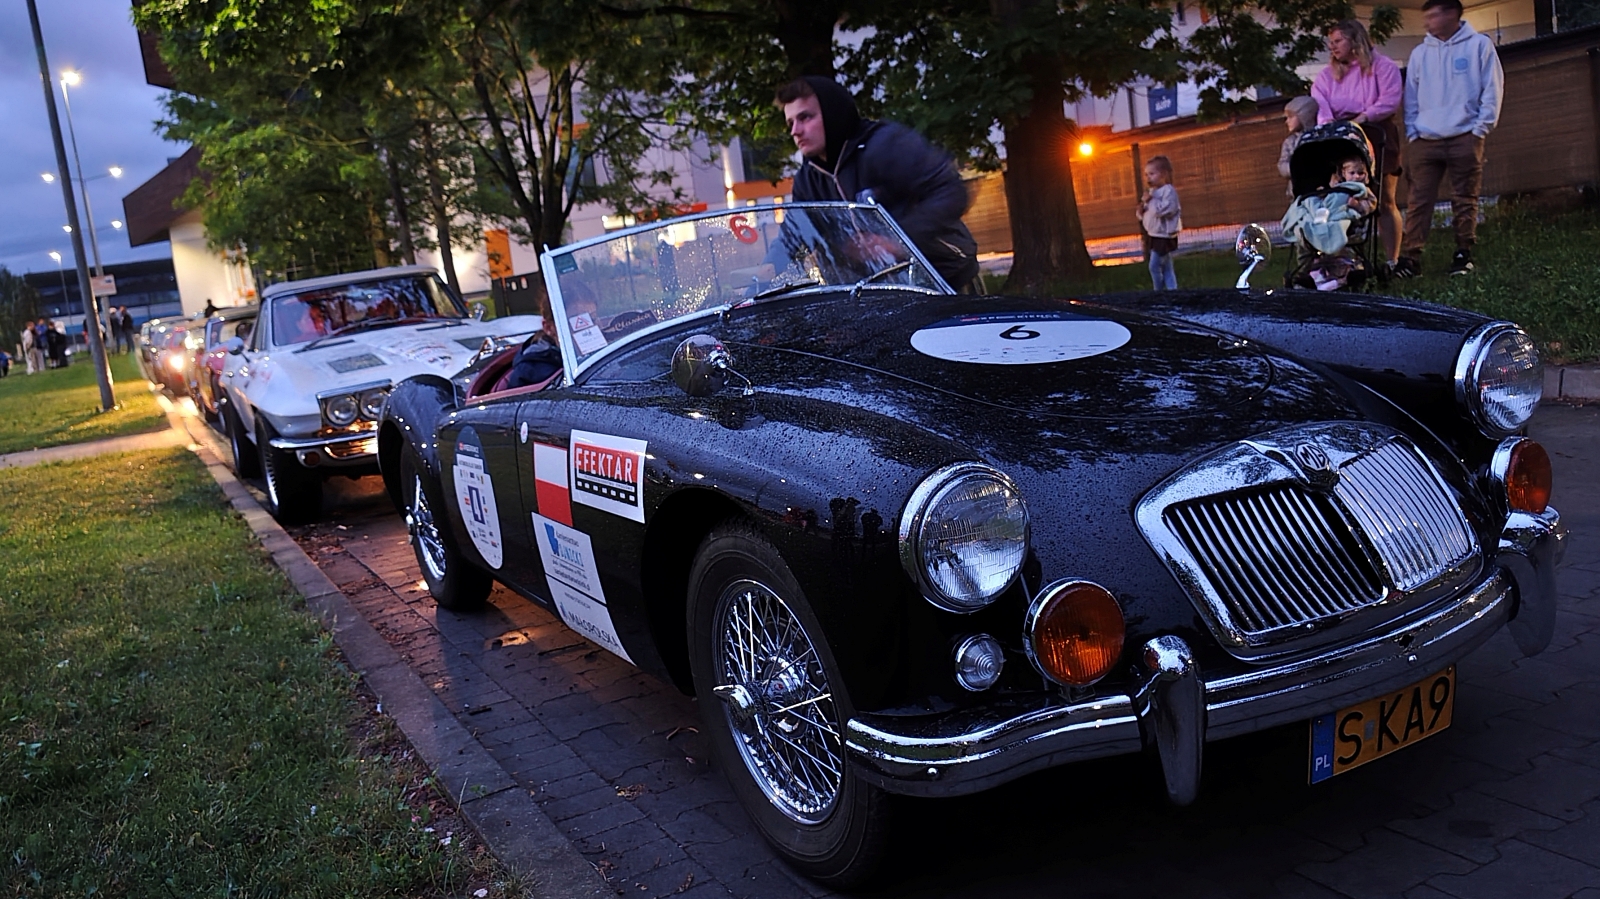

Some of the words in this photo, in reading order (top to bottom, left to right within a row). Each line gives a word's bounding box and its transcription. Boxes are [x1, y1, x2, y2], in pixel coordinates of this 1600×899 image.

[730, 215, 758, 244] 6
[999, 324, 1041, 340] 6
[575, 447, 633, 484] EFEKTAR
[1299, 445, 1327, 469] MG
[1337, 711, 1364, 765] S
[1377, 676, 1451, 752] KA9
[1315, 754, 1331, 772] PL
